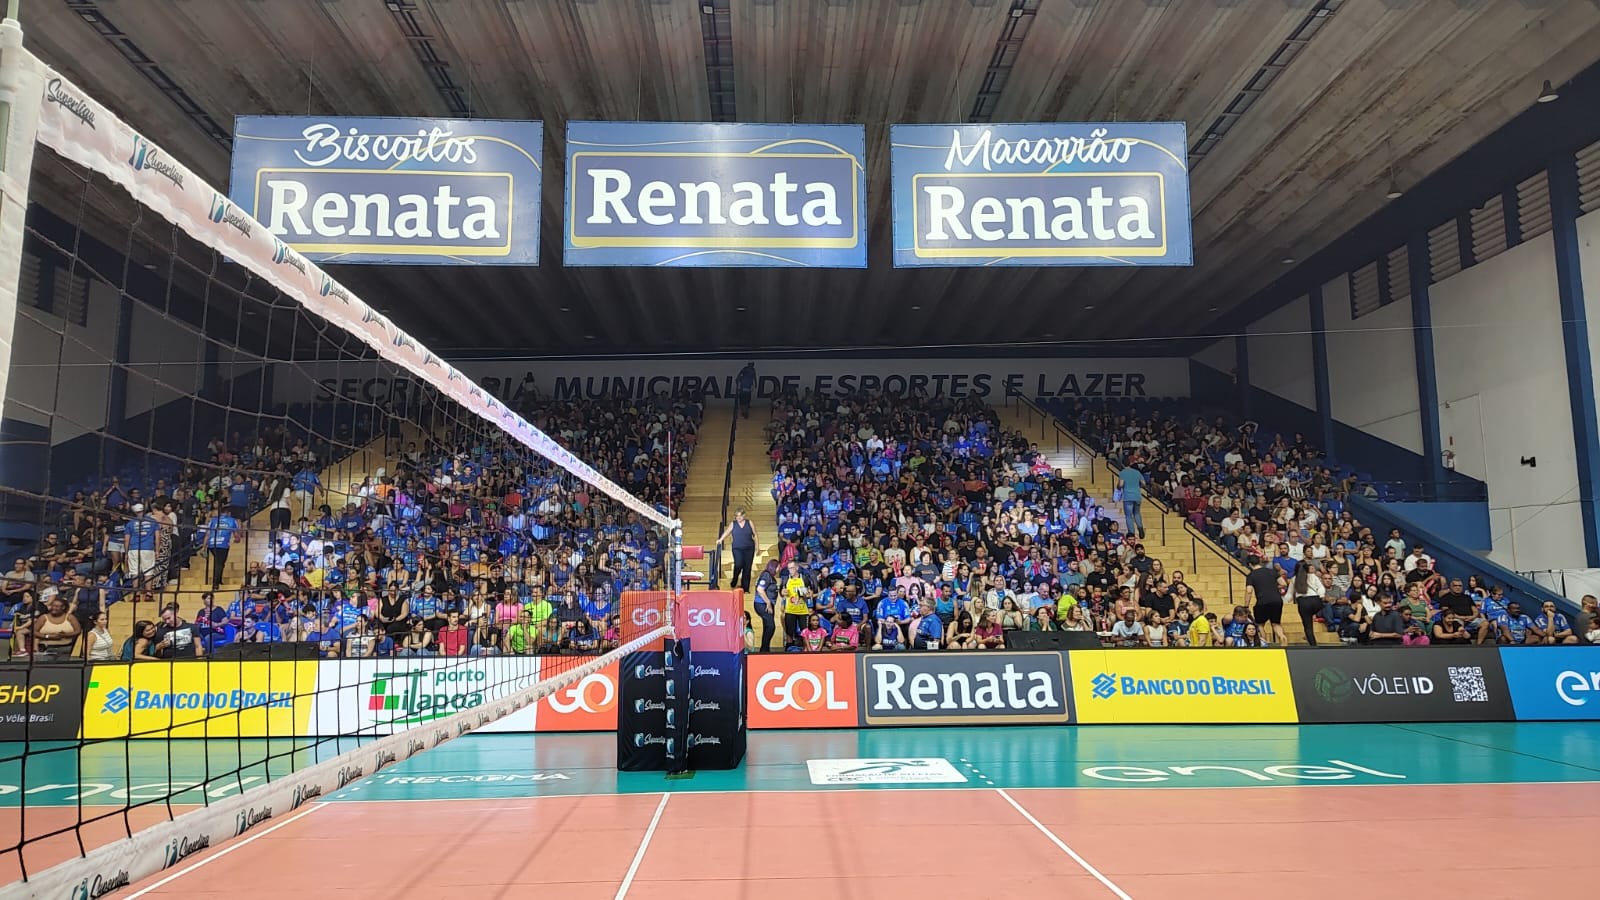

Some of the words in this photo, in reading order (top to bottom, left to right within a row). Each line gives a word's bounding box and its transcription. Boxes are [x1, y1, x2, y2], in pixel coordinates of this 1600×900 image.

[47, 77, 96, 130] Superliga
[294, 123, 477, 166] Biscoitos
[944, 128, 1138, 171] Macarrão
[266, 180, 500, 239] Renata
[586, 169, 842, 226] Renata
[924, 185, 1155, 241] Renata
[554, 376, 738, 400] MUNICIPAL
[757, 375, 801, 399] DE
[814, 374, 992, 398] ESPORTES
[1006, 374, 1024, 397] E
[1037, 373, 1146, 397] LAZER
[632, 608, 666, 626] GO
[688, 608, 726, 626] GOL
[436, 668, 485, 686] porto
[872, 663, 1059, 710] Renata
[1120, 677, 1184, 696] BANCO
[1187, 680, 1210, 696] DO
[1212, 676, 1276, 696] BRASIL
[1353, 673, 1410, 695] VÔLEI
[1413, 676, 1434, 695] ID
[0, 684, 60, 703] SHOP
[134, 690, 200, 709] BANCO
[202, 692, 227, 709] DO
[229, 689, 293, 709] BRASIL
[756, 670, 848, 711] GOL
[29, 713, 54, 723] Brasil
[1081, 760, 1407, 782] enel
